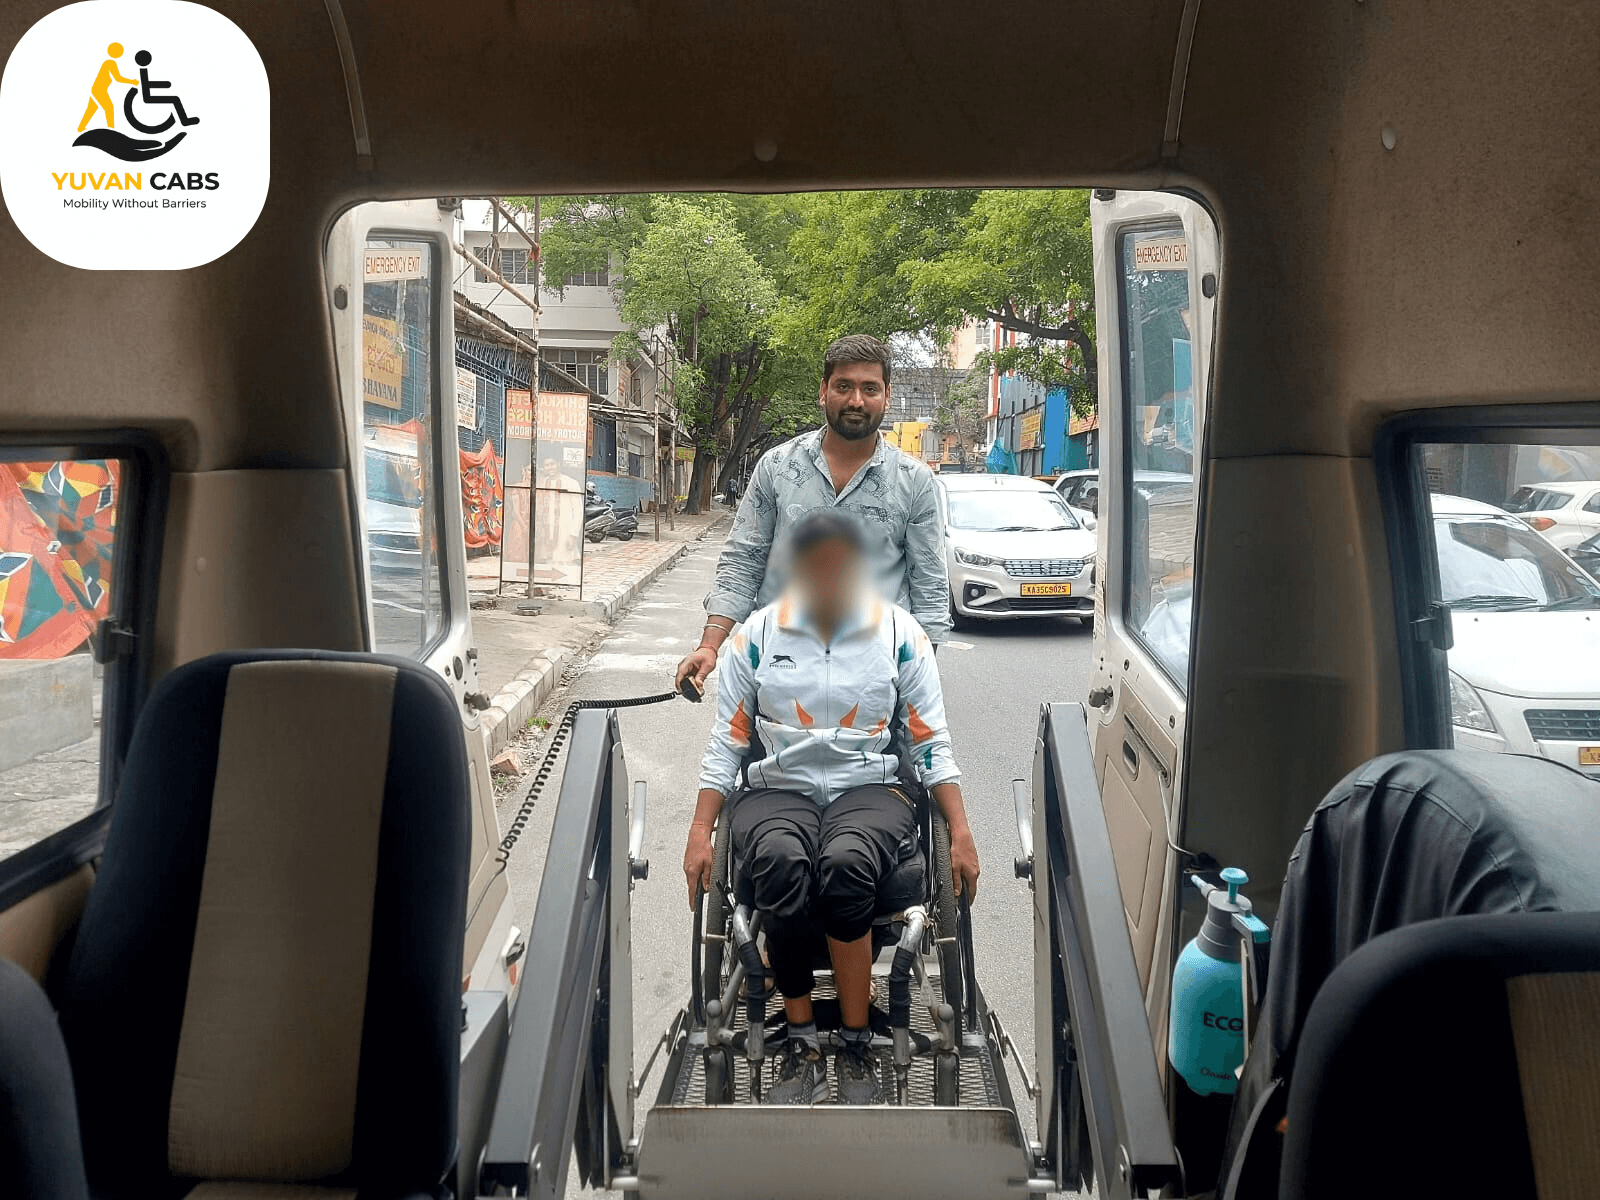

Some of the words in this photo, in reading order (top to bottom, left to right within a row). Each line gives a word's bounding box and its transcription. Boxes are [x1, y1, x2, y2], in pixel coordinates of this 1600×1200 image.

[1136, 246, 1172, 263] EMERGENCY
[1173, 244, 1188, 261] EXIT
[366, 256, 406, 274] EMERGENCY
[408, 256, 420, 272] EXIT
